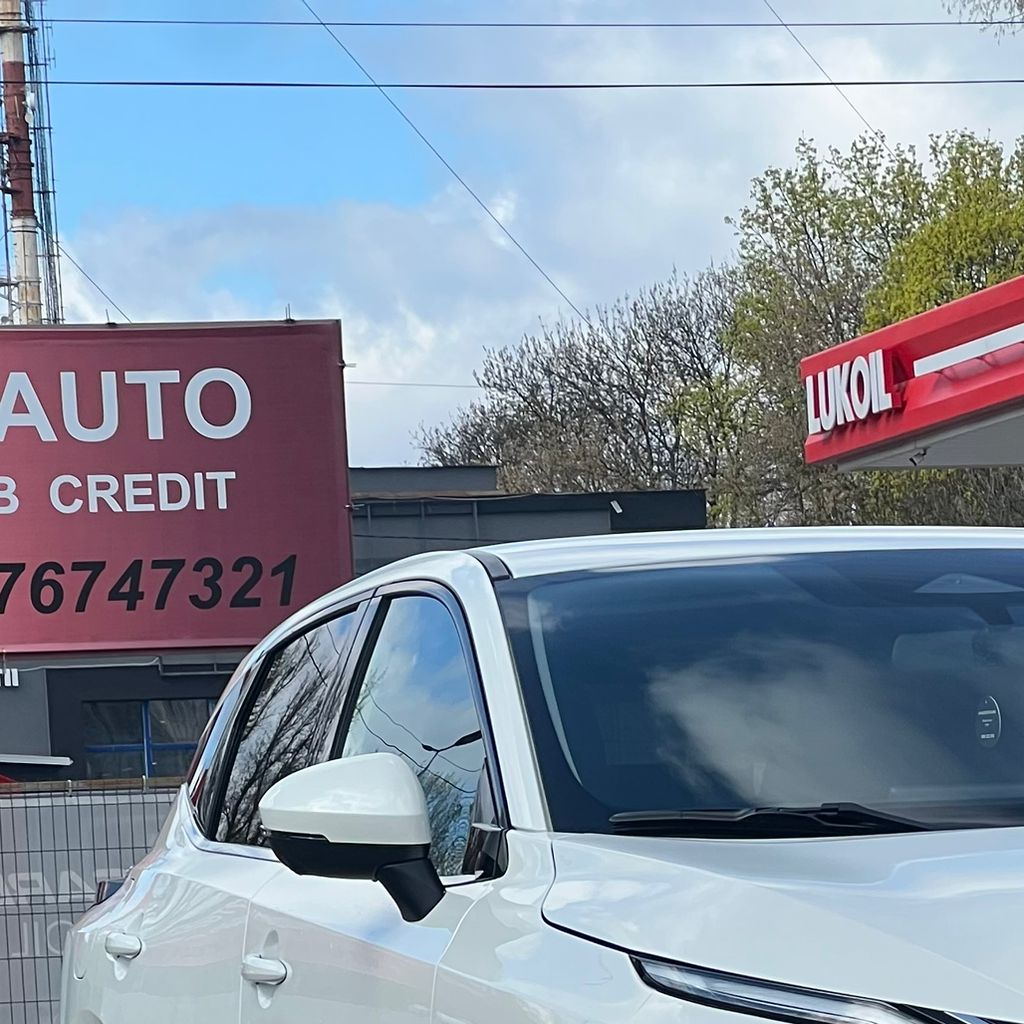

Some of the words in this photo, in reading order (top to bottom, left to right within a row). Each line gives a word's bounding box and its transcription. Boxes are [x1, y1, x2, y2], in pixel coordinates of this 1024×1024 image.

[0, 367, 252, 443] AUTO
[805, 348, 893, 435] LUKOIL
[49, 471, 236, 514] CREDIT
[0, 554, 297, 615] 76747321
